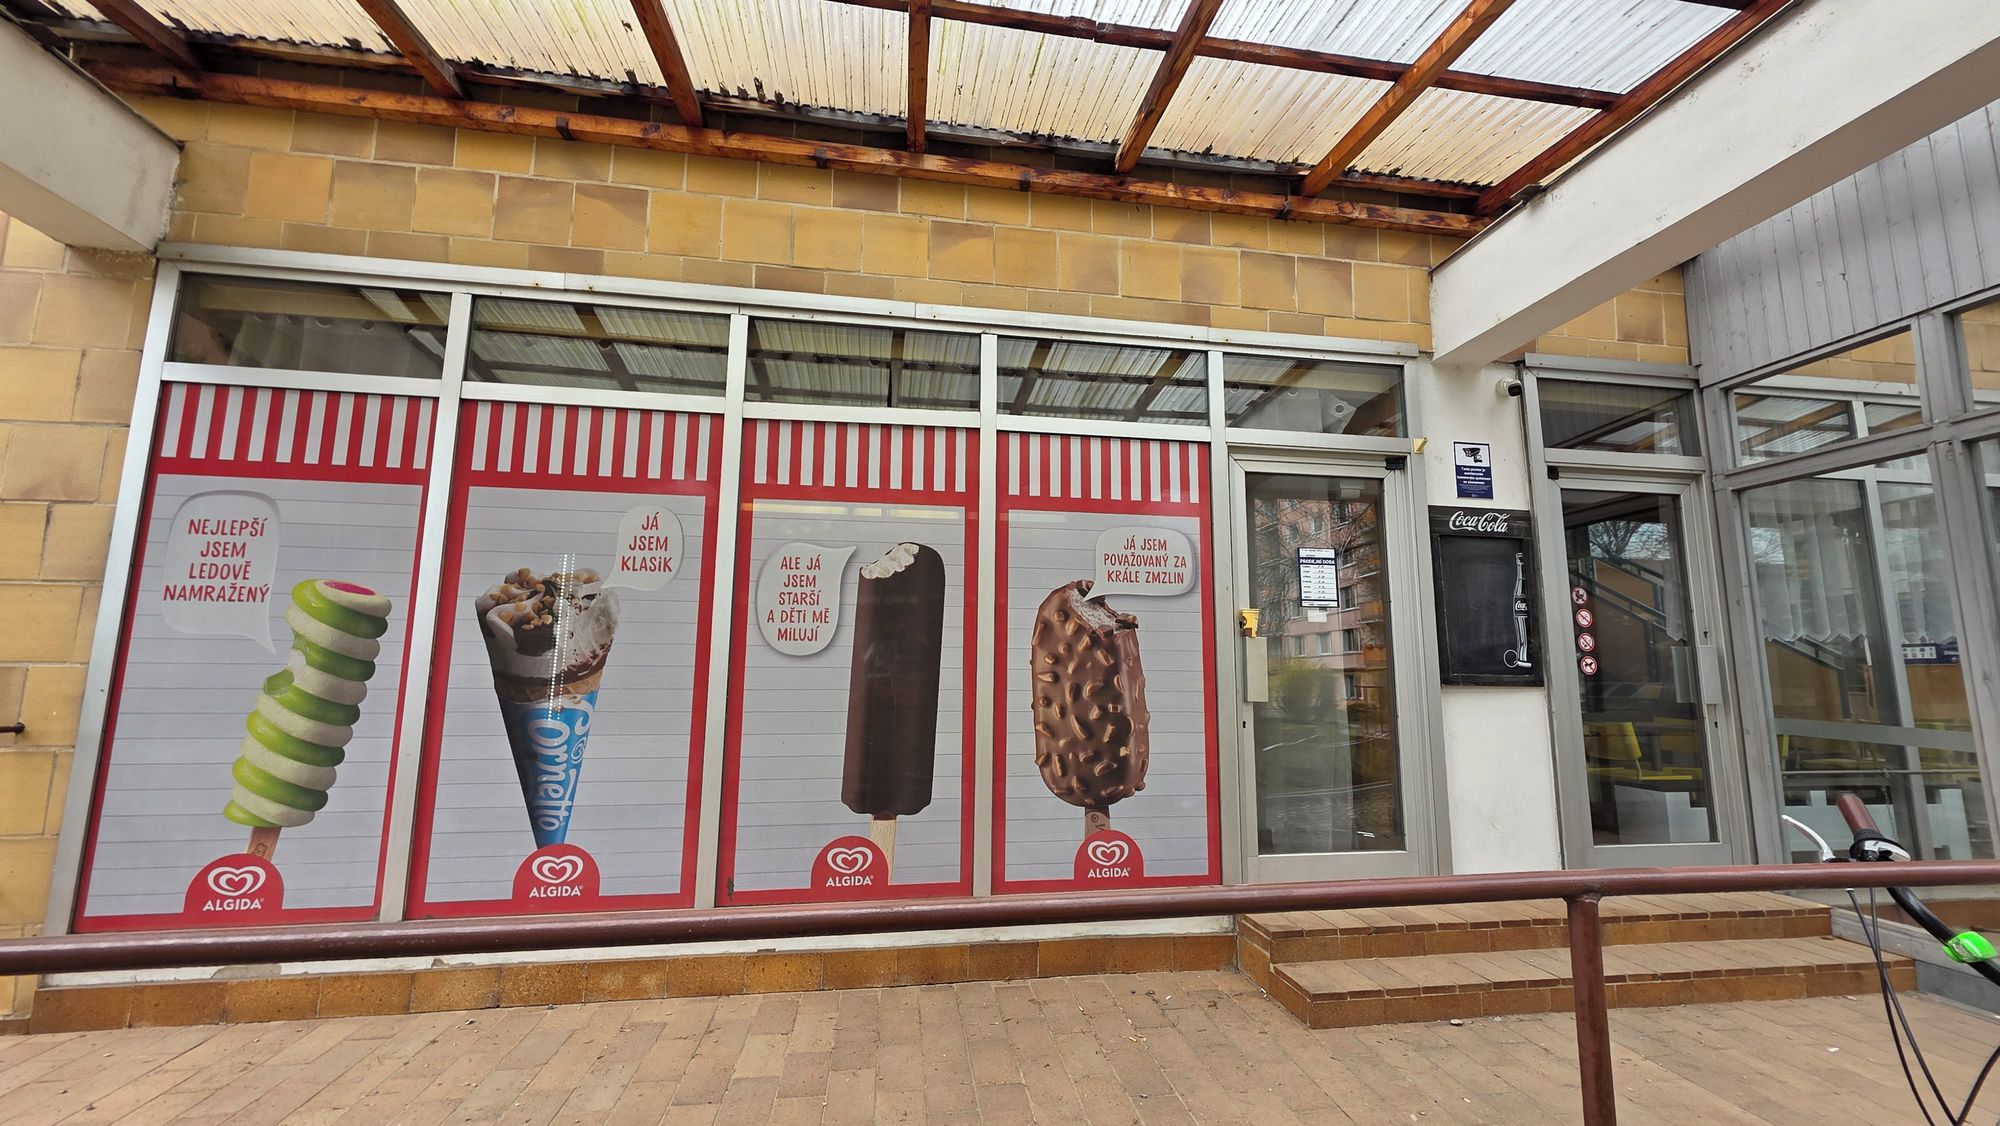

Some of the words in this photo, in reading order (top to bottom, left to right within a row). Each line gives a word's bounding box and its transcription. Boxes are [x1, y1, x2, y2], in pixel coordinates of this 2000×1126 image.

[188, 518, 268, 537] NEJLEPŠÍ
[642, 512, 660, 530] JÁ
[1449, 511, 1510, 532] Coca-Cola
[200, 541, 246, 559] JSEM
[628, 536, 668, 552] JSEM
[1124, 534, 1136, 550] JÁ
[1140, 538, 1167, 551] JSEM
[621, 556, 672, 572] KLASIK
[780, 556, 800, 570] ALE
[806, 554, 821, 570] JÁ
[1104, 552, 1168, 568] POVAŽOVANÝ
[1174, 556, 1187, 568] ZA
[188, 561, 252, 580] LEDOVĚ
[1107, 567, 1140, 583] KRÁLE
[1145, 571, 1184, 584] ZMZLIN
[784, 574, 816, 588] JSEM
[163, 583, 270, 603] NAMRAŽENÝ
[779, 590, 822, 606] STARŠÍ
[767, 609, 775, 623] A
[780, 607, 806, 623] DĚTI
[812, 608, 830, 624] MĚ
[777, 626, 819, 642] MILUJÍ
[522, 695, 594, 831] Cornetto
[1088, 868, 1129, 878] ALGIDA
[826, 876, 872, 887] ALGIDA
[529, 885, 581, 898] ALGIDA
[203, 898, 262, 911] ALGIDA
